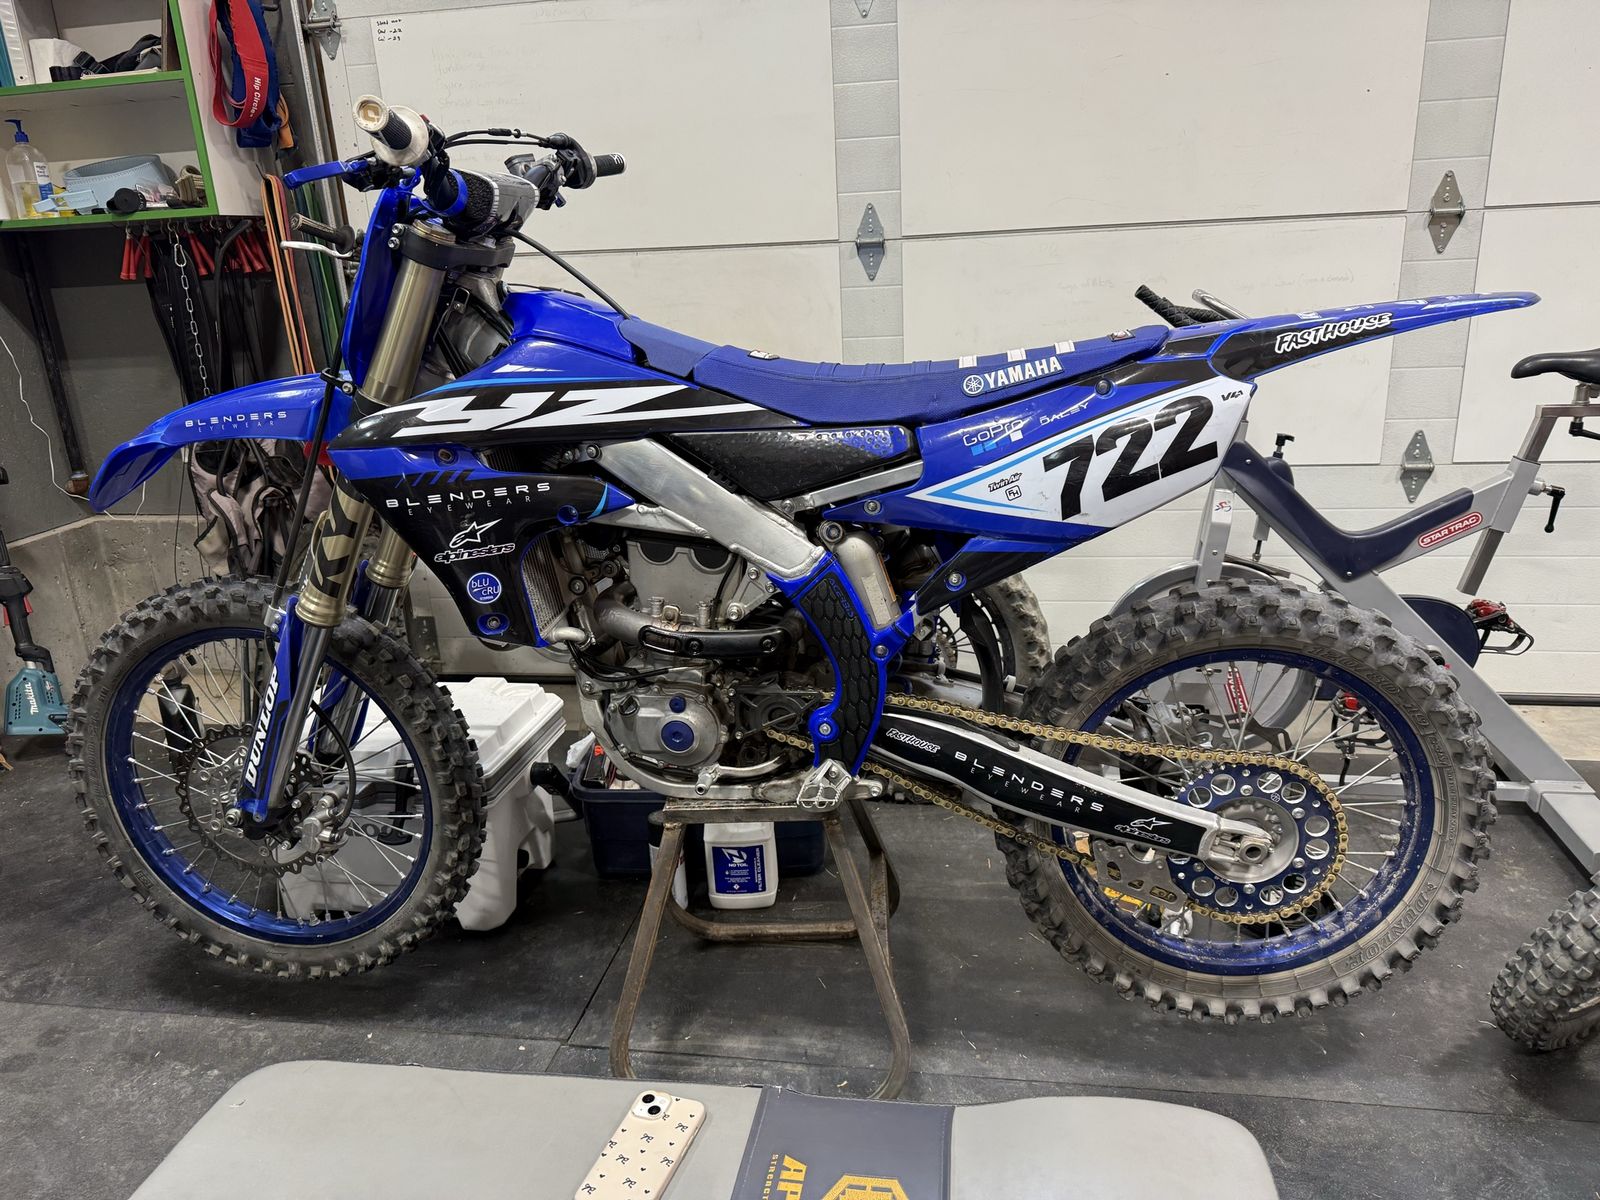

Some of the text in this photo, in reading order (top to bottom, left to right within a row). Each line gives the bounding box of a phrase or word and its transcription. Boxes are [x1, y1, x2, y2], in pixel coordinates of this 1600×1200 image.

[249, 76, 262, 114] Hip Circle
[1274, 312, 1394, 354] FASTHOUSE
[984, 356, 1062, 389] YAMAHA
[184, 411, 287, 428] BLENDERS
[198, 420, 274, 433] EYEWEAR
[962, 419, 1024, 447] GoPro
[1042, 395, 1218, 521] 722
[386, 482, 551, 508] BLENDERS
[988, 472, 1023, 492] Twin Air
[408, 495, 531, 516] EYEWEAR
[1423, 516, 1478, 544] STAR TRAC
[434, 542, 516, 565] alpinestars
[471, 577, 490, 588] bLU
[481, 585, 500, 596] cRU
[24, 681, 39, 716] makita
[245, 665, 279, 788] DUNLOP
[886, 728, 940, 754] FASTHOUSE
[954, 751, 1104, 812] BLENDERS
[970, 767, 1080, 814] EYEWEAR
